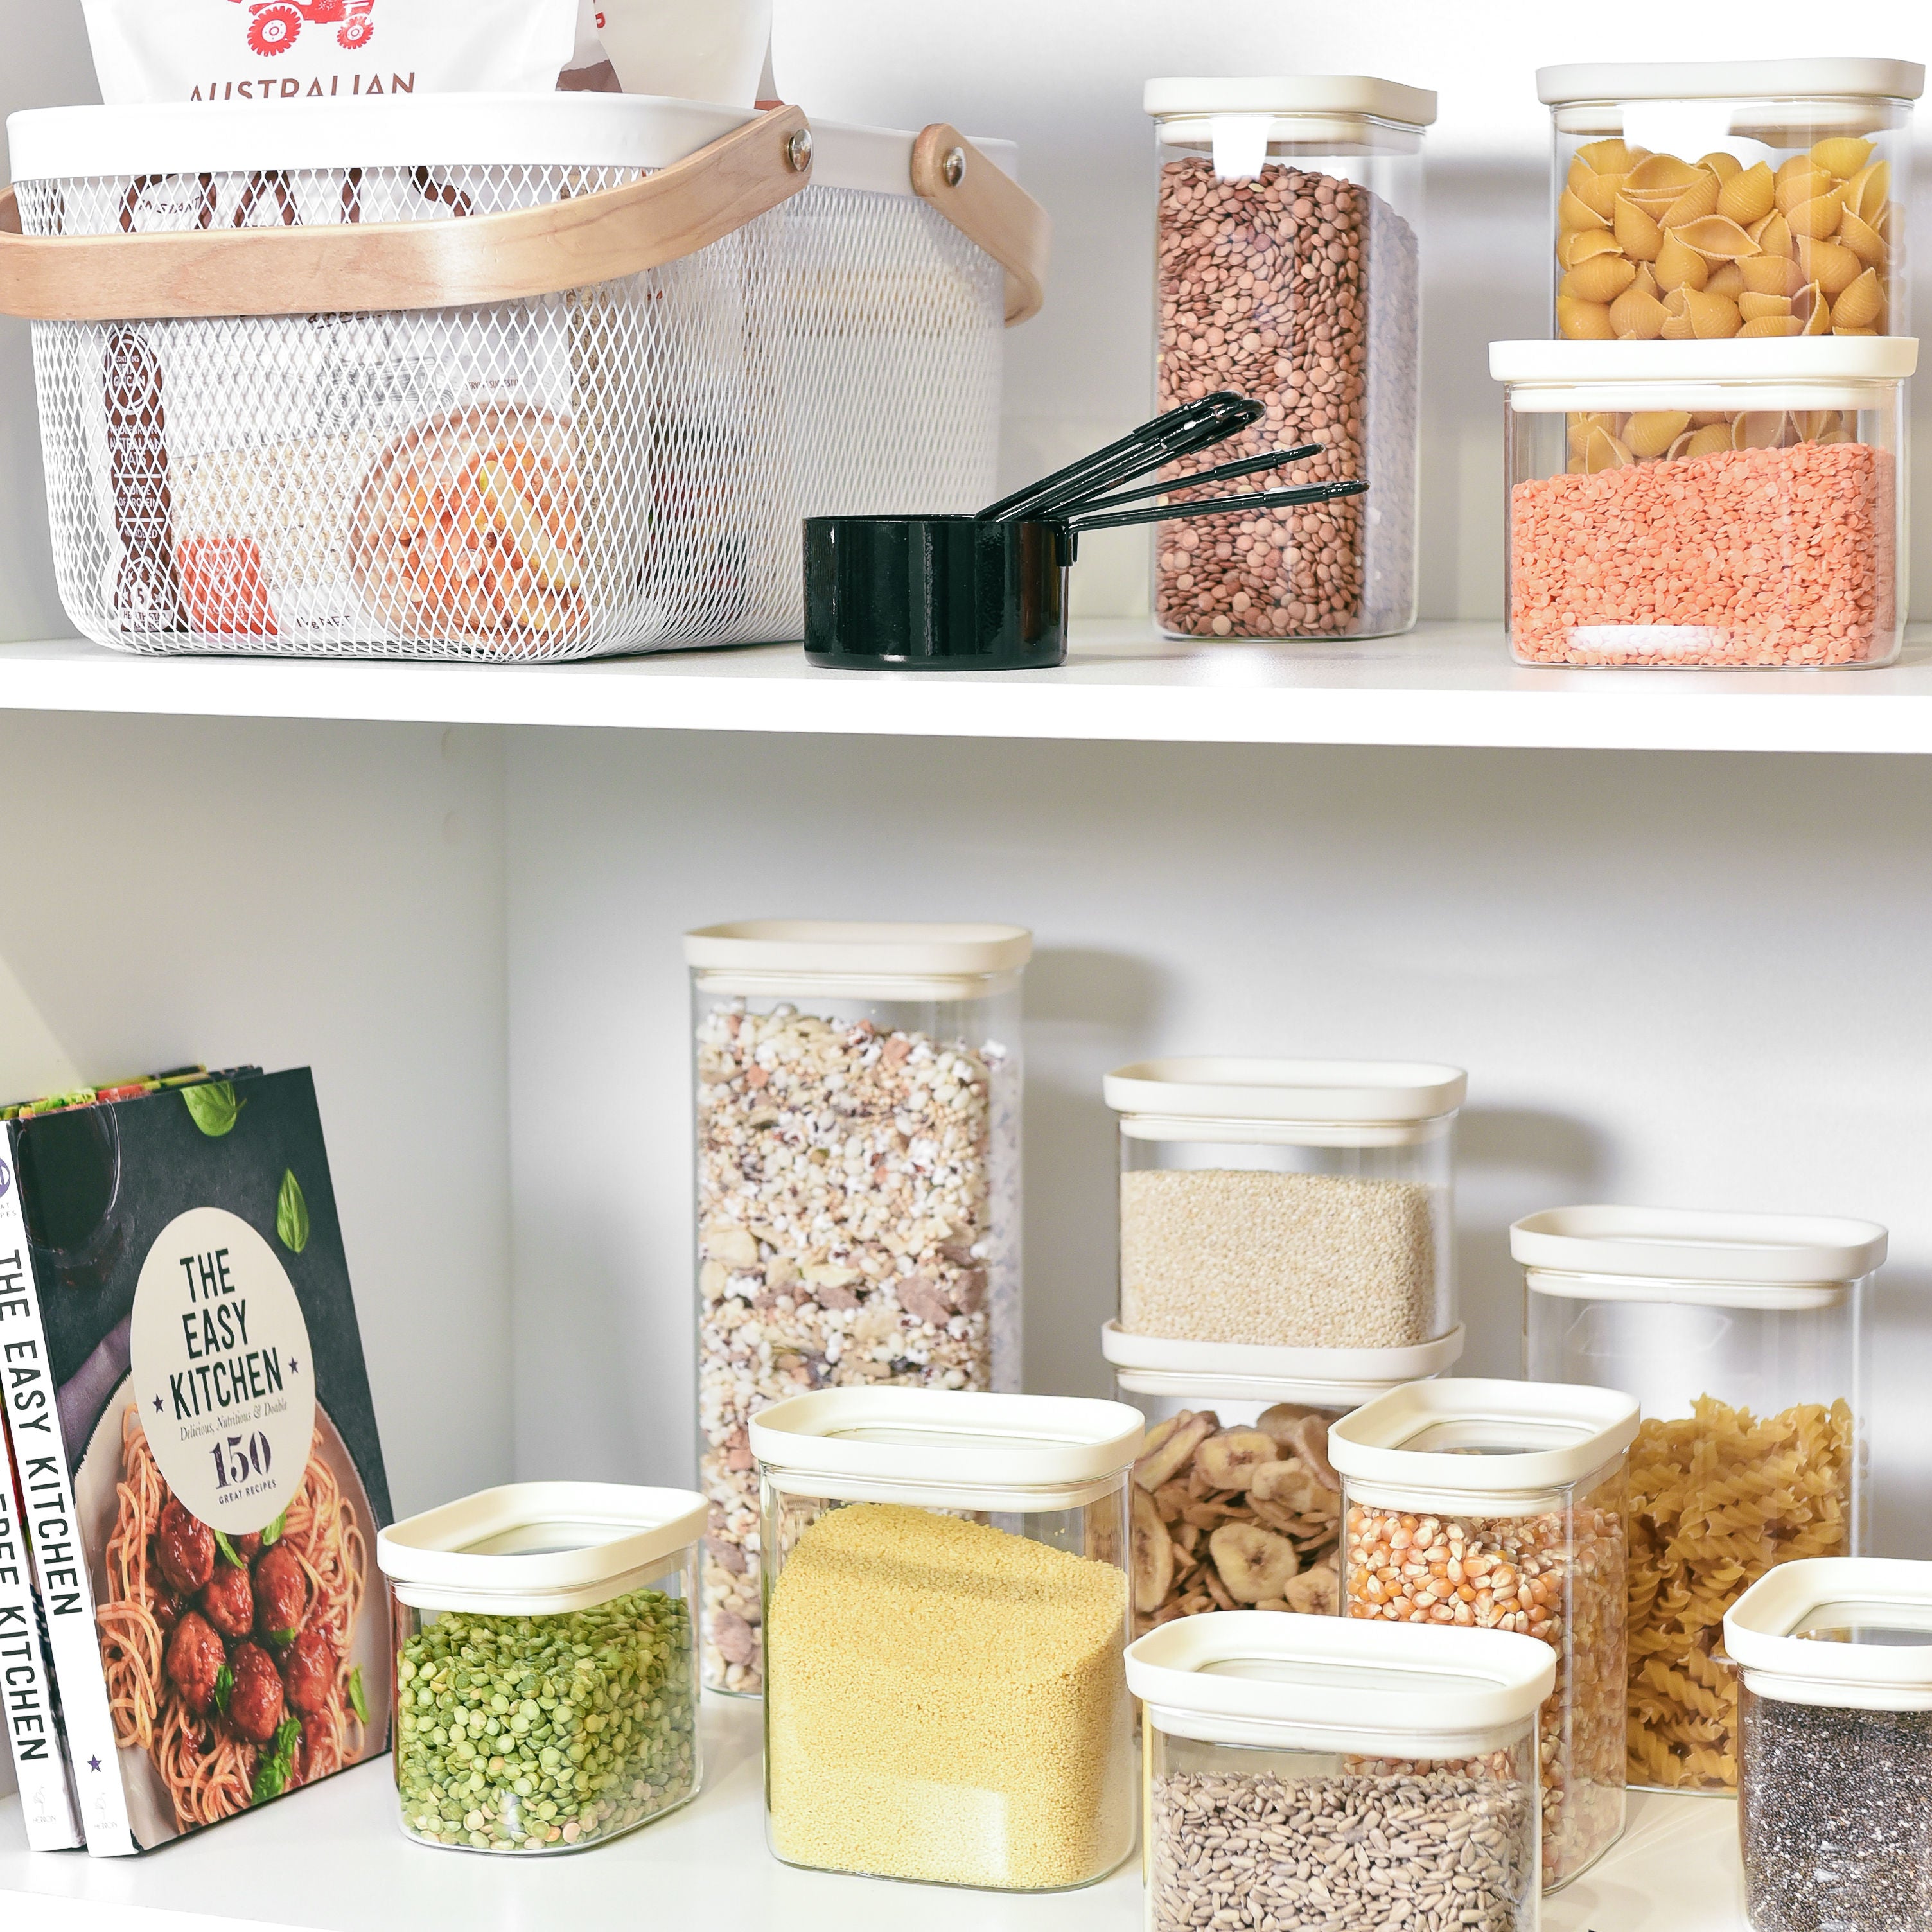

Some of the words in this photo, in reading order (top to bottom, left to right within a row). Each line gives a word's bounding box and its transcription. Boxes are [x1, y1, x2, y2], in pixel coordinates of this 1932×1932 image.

[128, 497, 158, 507] ROEIN
[123, 611, 146, 620] HELTH
[137, 588, 145, 604] 5
[0, 1249, 30, 1321] THE
[180, 1248, 235, 1303] THE
[182, 1299, 248, 1360] EASY
[4, 1340, 51, 1432] EASY
[170, 1347, 283, 1420] KITCHEN
[216, 1412, 251, 1431] Nutritious
[209, 1430, 271, 1489] 150
[218, 1489, 243, 1505] GREAT
[246, 1479, 276, 1496] RECIPES
[26, 1456, 82, 1615] KITCHEN
[0, 1605, 49, 1761] KITCHEN
